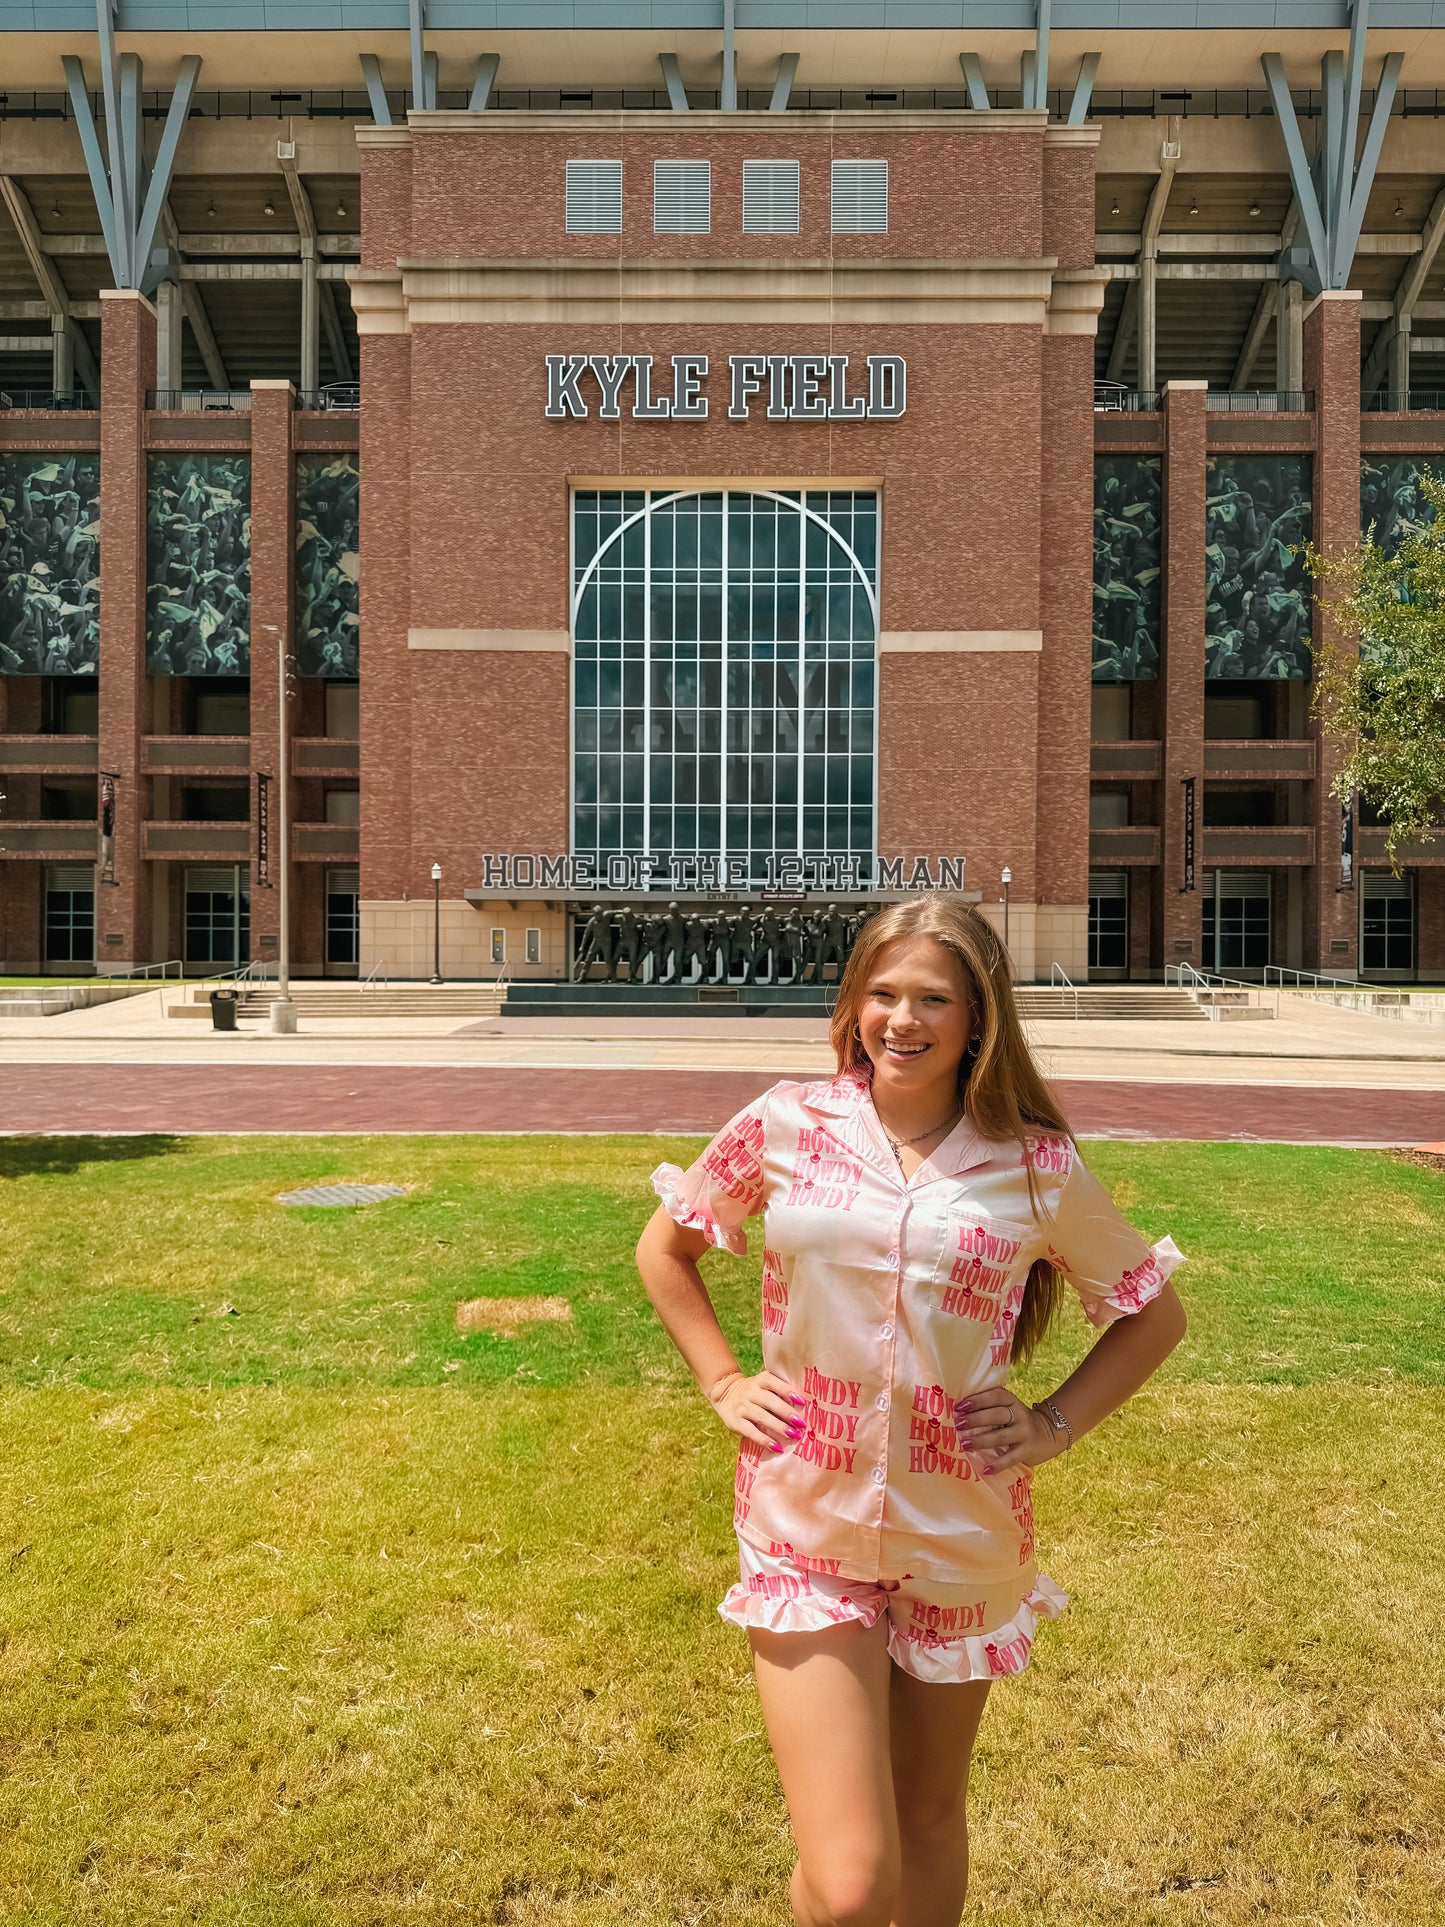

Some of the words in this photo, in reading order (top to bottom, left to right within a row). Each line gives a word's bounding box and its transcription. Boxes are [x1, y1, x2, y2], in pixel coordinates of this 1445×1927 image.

[545, 355, 709, 419] KYLE
[728, 355, 907, 419] FIELD
[481, 853, 595, 889] HOME
[606, 854, 659, 889] OF
[669, 855, 748, 891] THE
[764, 856, 862, 891] 12TH
[876, 857, 966, 892] MAN
[707, 892, 731, 901] ENTRY
[792, 1156, 864, 1186] HOWDY
[786, 1183, 861, 1211] HOWDY
[958, 1225, 1022, 1265] HOWDY
[949, 1256, 1011, 1294] HOWDY
[940, 1285, 1001, 1324] HOWDY
[803, 1366, 861, 1409] HOWDY
[909, 1415, 965, 1454] HOW
[910, 1600, 987, 1631] HOWDY
